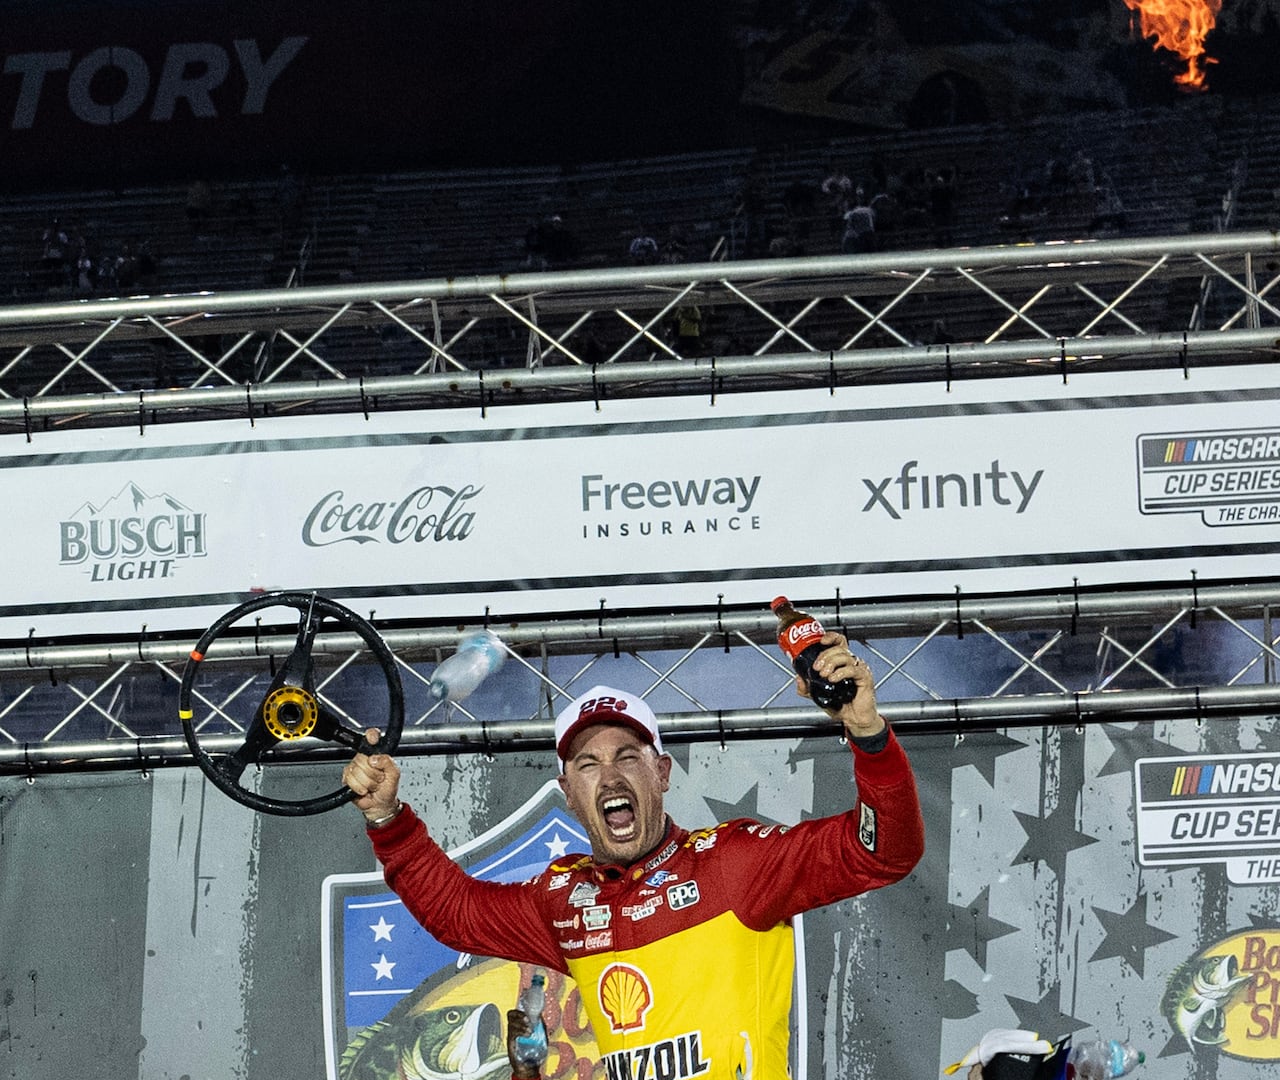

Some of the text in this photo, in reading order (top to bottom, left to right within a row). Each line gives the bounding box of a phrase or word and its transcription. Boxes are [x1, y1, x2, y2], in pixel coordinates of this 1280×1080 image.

[583, 474, 761, 516] Freeway
[861, 460, 1045, 520] xfinity
[1164, 473, 1210, 495] CUP
[302, 483, 485, 548] Coca-Cola
[1217, 507, 1246, 522] THE
[59, 512, 208, 567] BUSCH
[582, 516, 761, 540] INSURANCE
[91, 559, 171, 583] LIGHT
[1170, 813, 1230, 840] CUP
[669, 881, 696, 907] PPG
